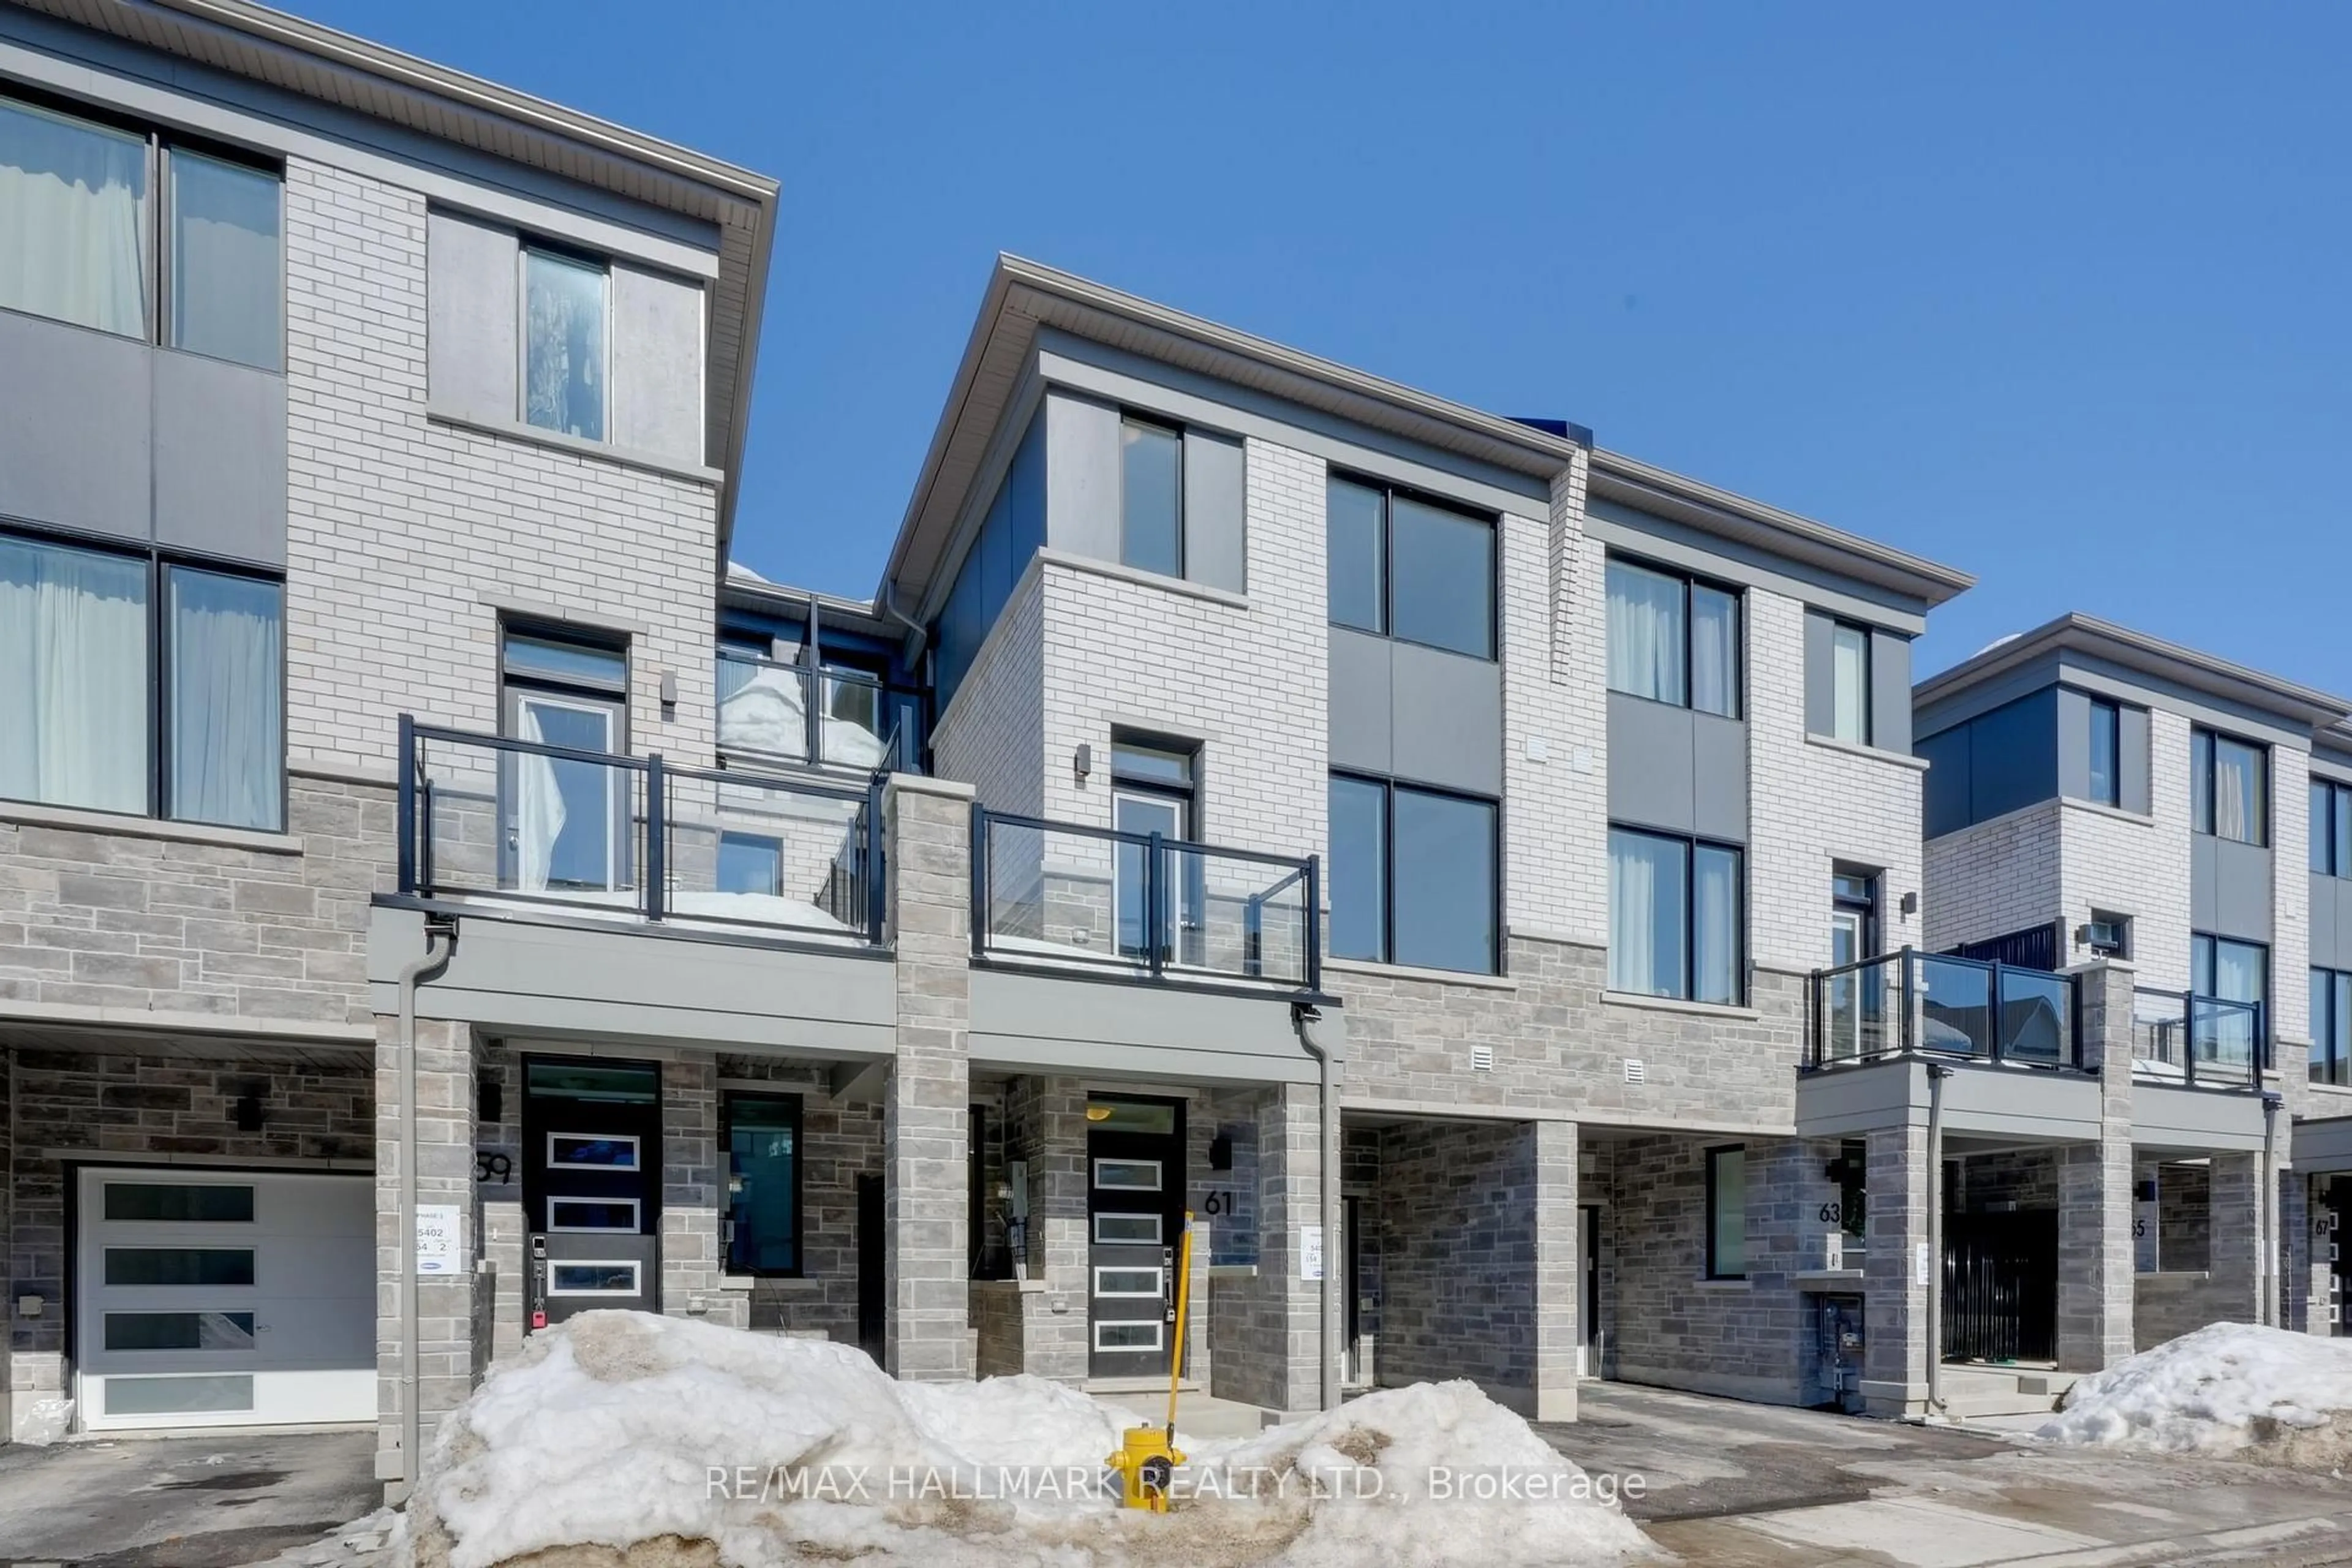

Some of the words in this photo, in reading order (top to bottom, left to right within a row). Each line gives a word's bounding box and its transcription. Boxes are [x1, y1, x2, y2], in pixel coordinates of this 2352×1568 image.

[477, 1152, 511, 1185] 59
[1205, 1190, 1231, 1215] 61
[1820, 1203, 1840, 1222] 63
[2316, 1219, 2328, 1235] 67
